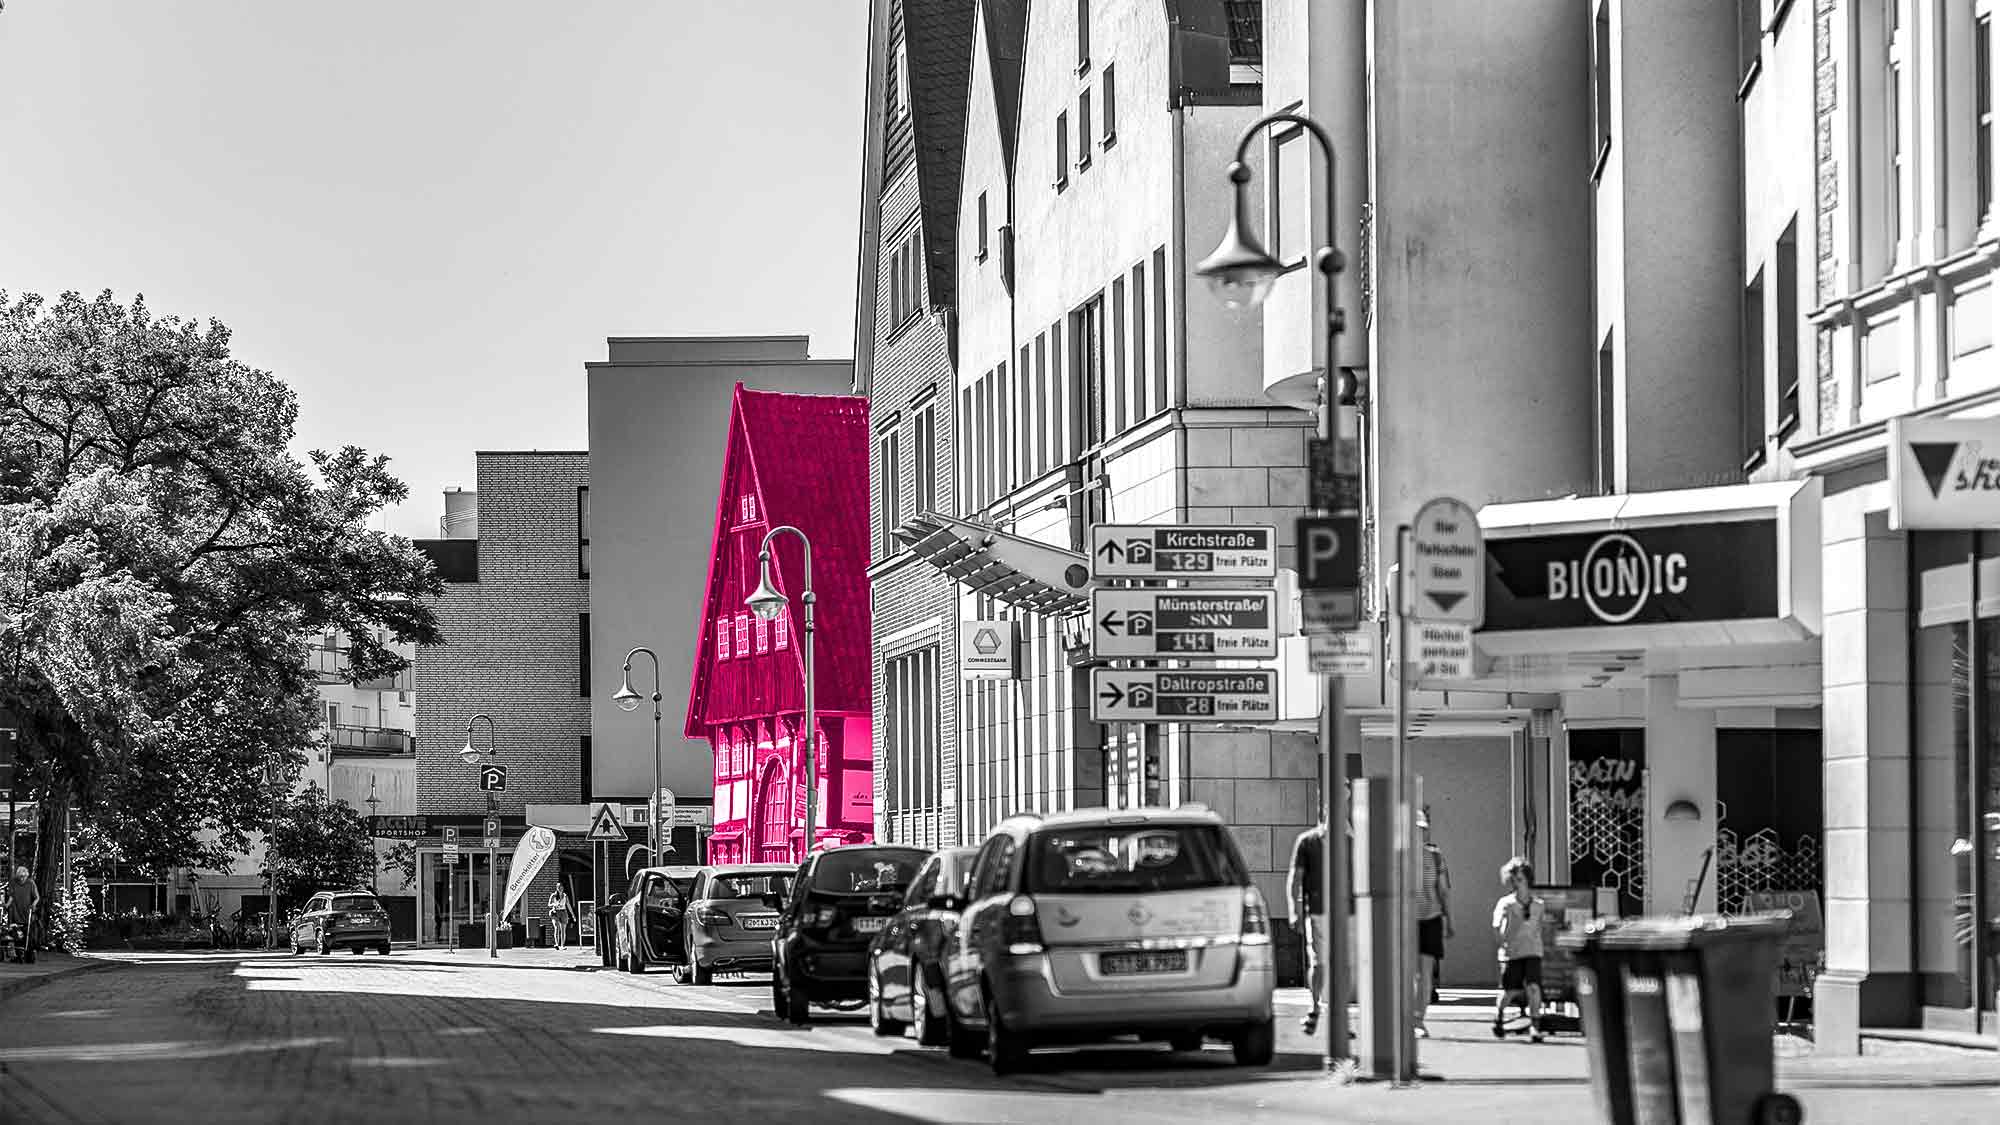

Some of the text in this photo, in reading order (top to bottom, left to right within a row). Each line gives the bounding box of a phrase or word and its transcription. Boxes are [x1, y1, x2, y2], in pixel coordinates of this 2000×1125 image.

[1166, 532, 1256, 547] Kirchstraße
[1171, 553, 1268, 570] 129 freie Plätze
[1308, 528, 1340, 581] P
[1547, 552, 1688, 601] BIONIC
[1158, 598, 1265, 612] Münsterstraße/
[1189, 613, 1233, 626] SINN
[1172, 633, 1269, 650] 141 freie Plätze
[1159, 677, 1265, 692] Daltropstraße
[1185, 698, 1269, 714] 28 freie Plätze
